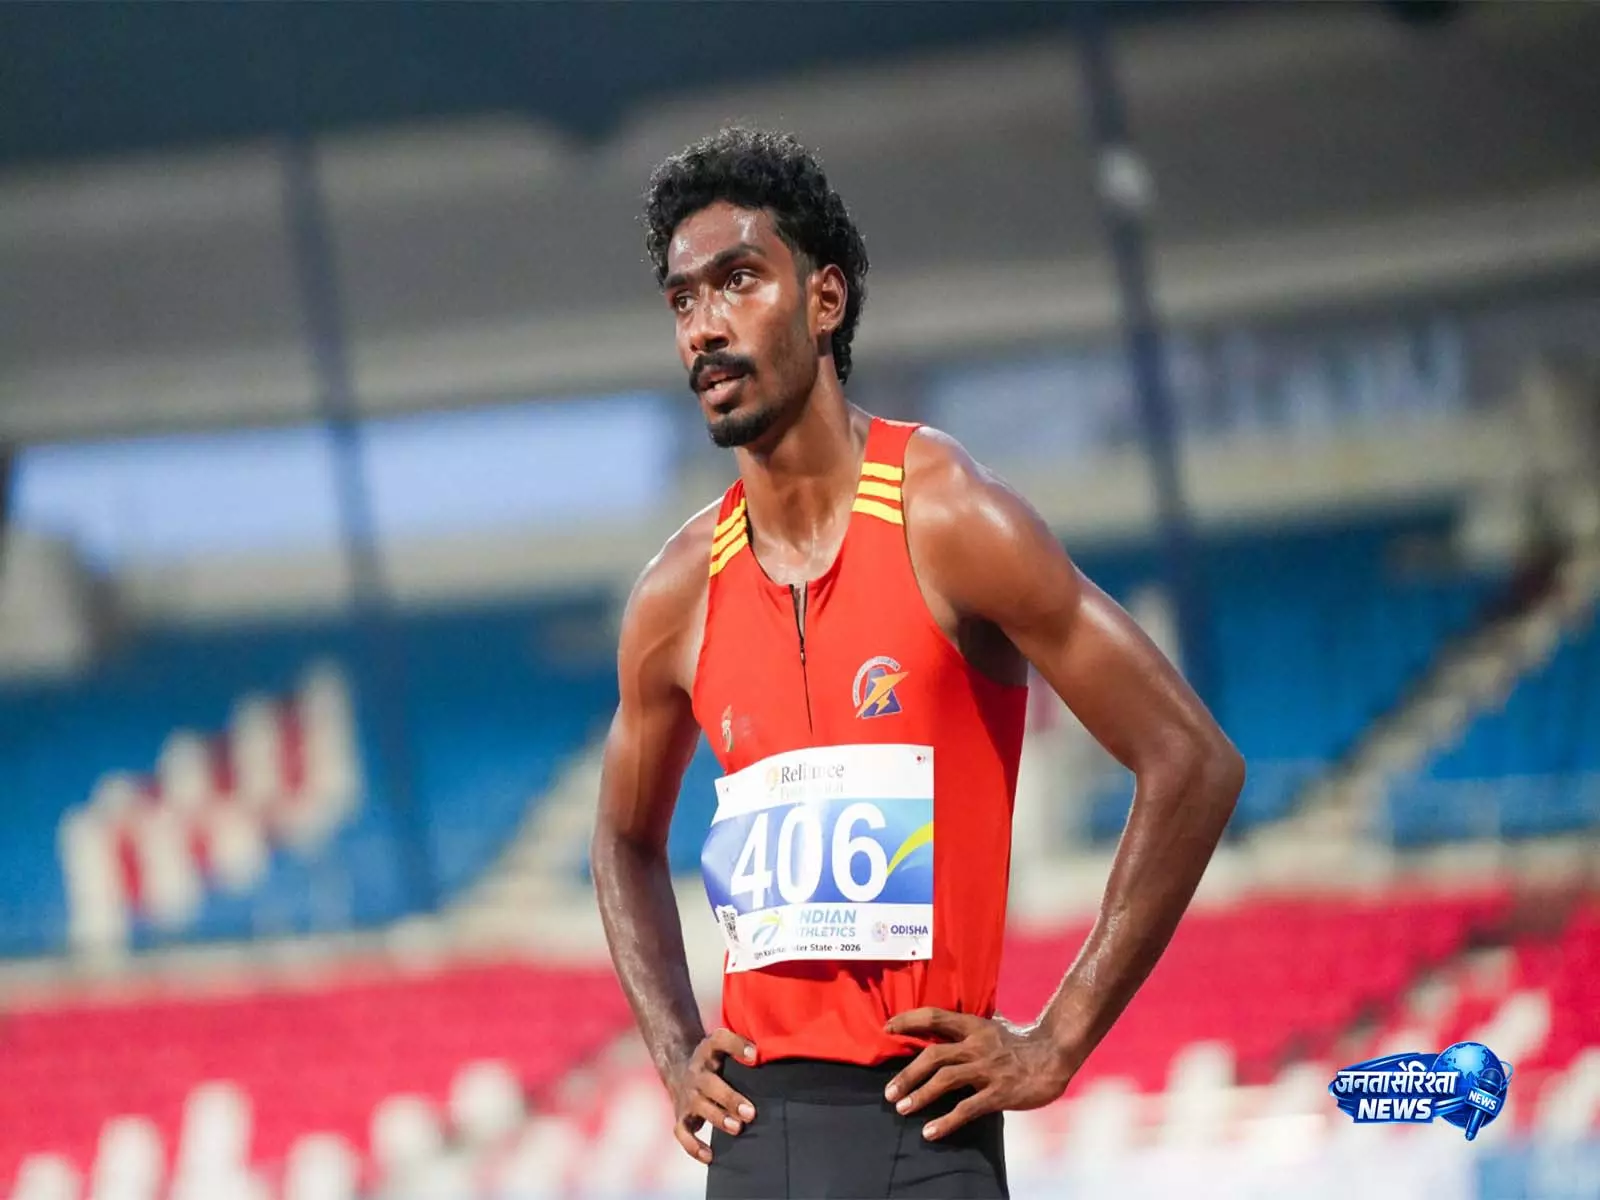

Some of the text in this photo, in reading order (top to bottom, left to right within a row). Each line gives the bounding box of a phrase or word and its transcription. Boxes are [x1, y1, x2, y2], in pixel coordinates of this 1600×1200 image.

[731, 803, 888, 908] 406
[798, 909, 857, 924] NDIAN
[796, 925, 856, 938] THLETICS
[890, 924, 929, 935] ODISHA
[810, 943, 833, 952] State
[840, 943, 862, 952] 2026
